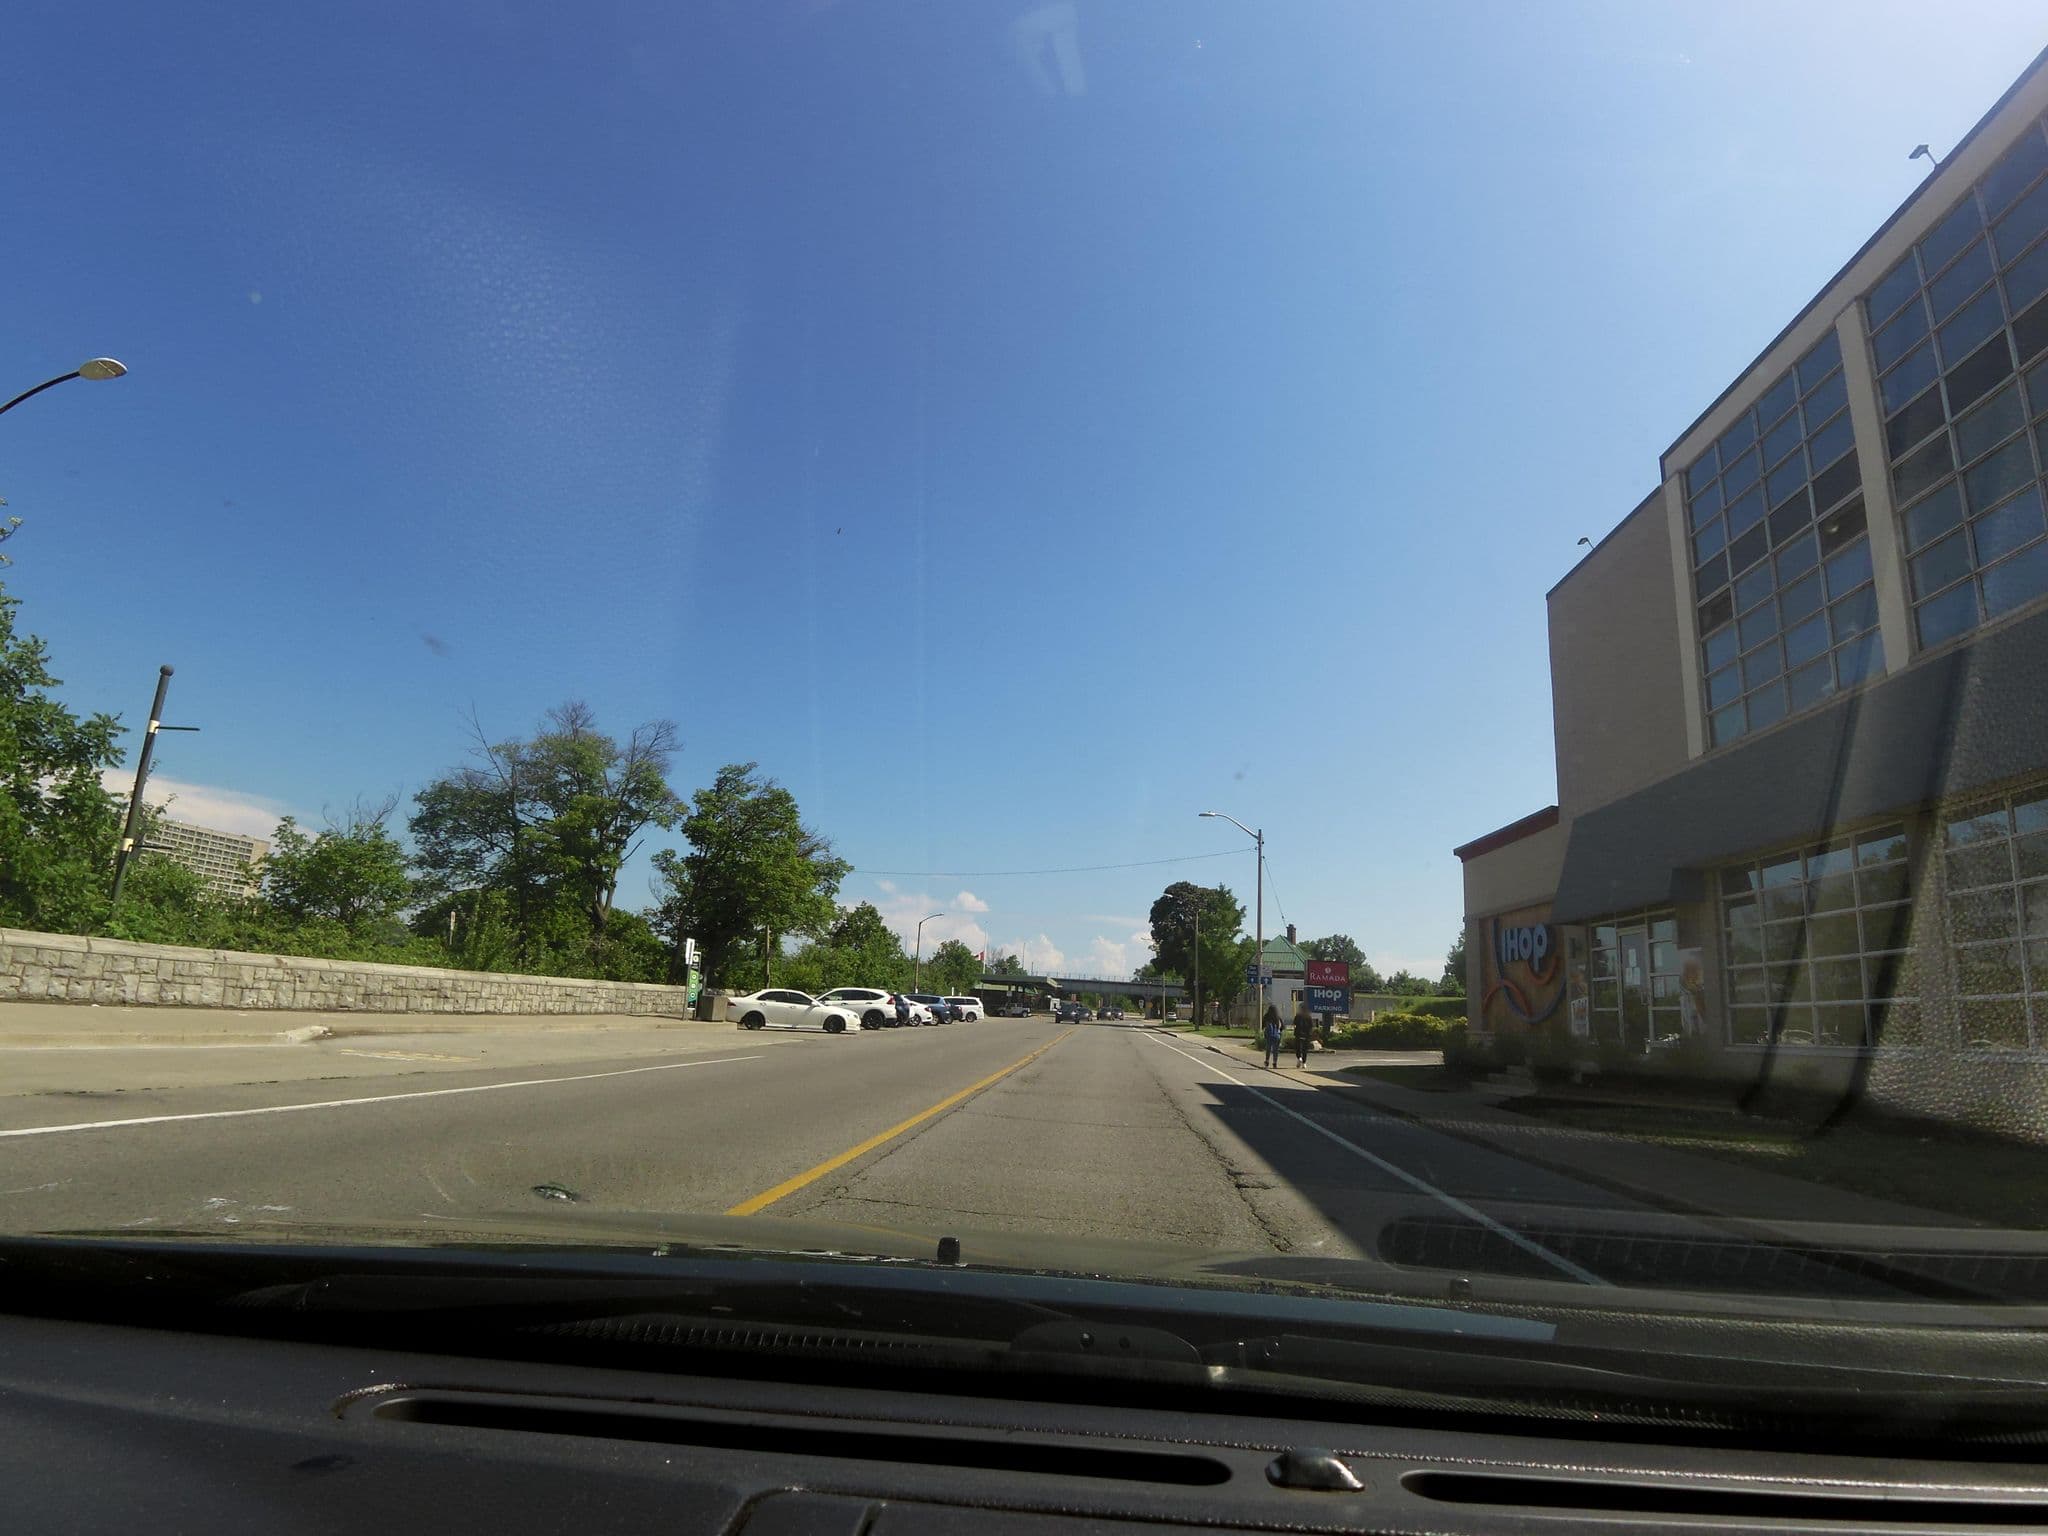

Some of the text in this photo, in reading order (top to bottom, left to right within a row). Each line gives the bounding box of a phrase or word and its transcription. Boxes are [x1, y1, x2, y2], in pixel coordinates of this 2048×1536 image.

[1501, 922, 1548, 972] IHOP
[1310, 972, 1346, 982] RAMADA
[1313, 989, 1342, 1001] IHOP
[1313, 1004, 1343, 1012] PARKING
